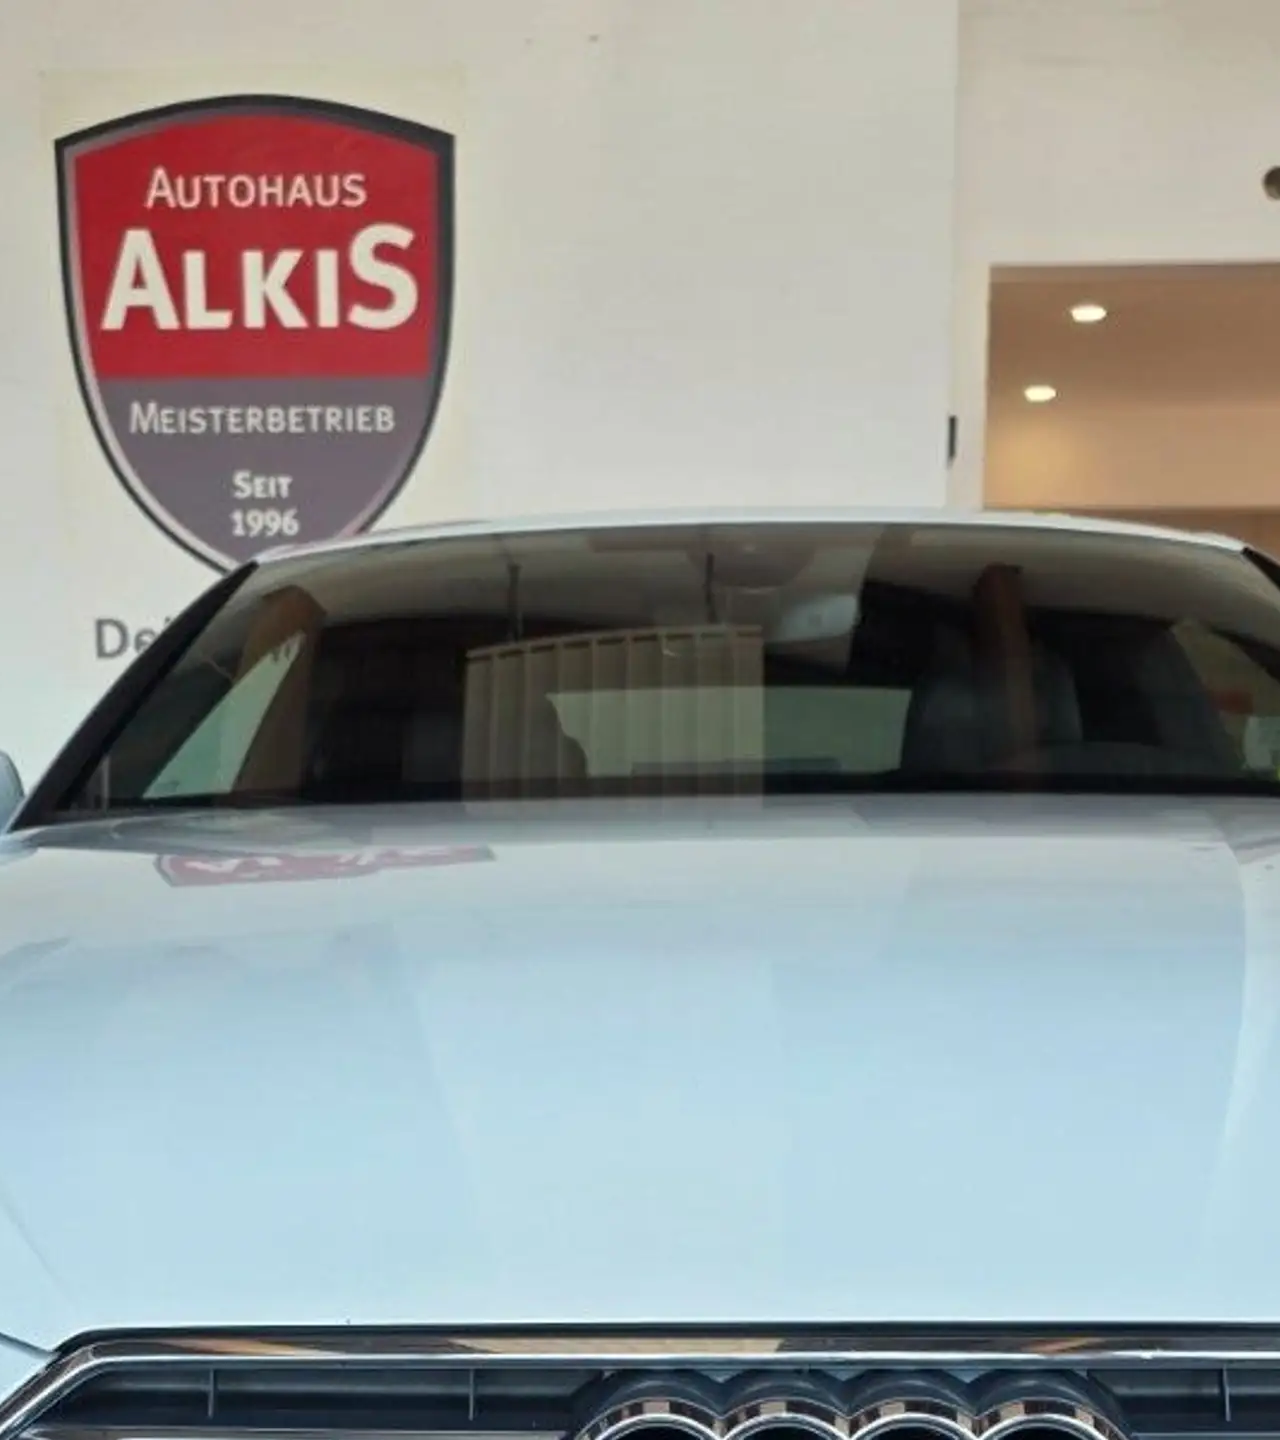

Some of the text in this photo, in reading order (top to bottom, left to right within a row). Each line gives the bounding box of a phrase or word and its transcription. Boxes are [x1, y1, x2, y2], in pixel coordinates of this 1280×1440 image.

[145, 166, 367, 209] AUTOHAUS
[101, 223, 418, 330] ALKIS
[130, 401, 395, 433] MEISTERBETRIEB
[233, 471, 292, 499] SEIT
[230, 509, 299, 536] 1996
